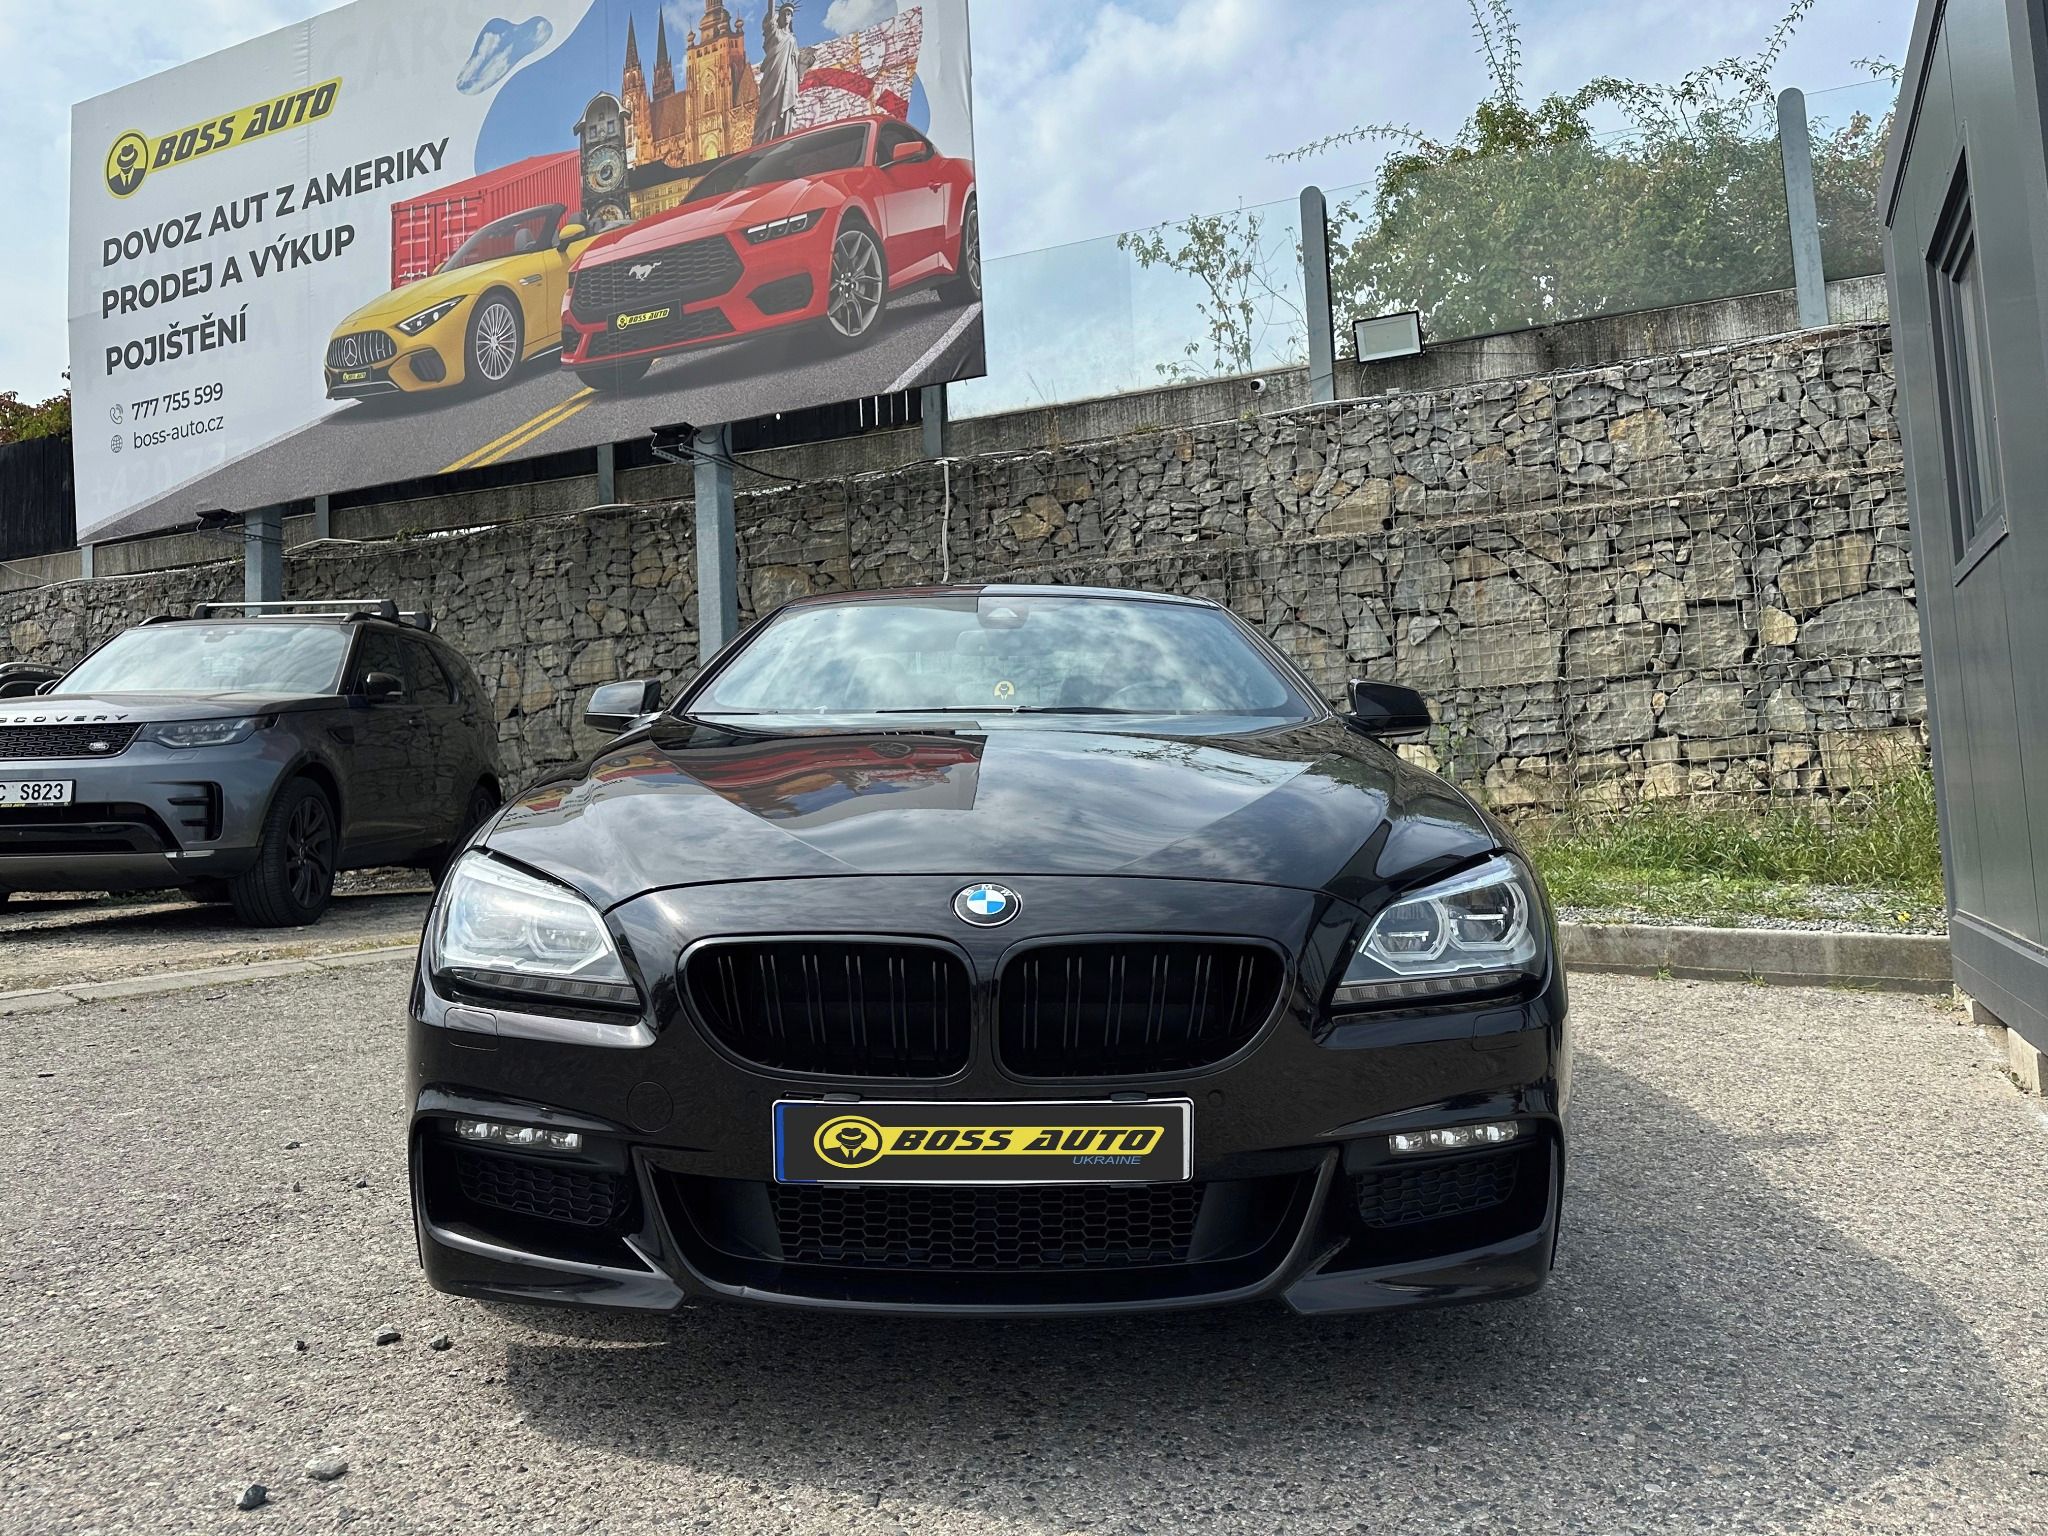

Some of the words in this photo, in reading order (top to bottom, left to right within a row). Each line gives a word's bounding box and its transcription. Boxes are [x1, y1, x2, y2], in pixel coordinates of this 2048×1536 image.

[152, 115, 236, 169] BOSS
[241, 82, 337, 141] AUTO
[103, 211, 202, 267] DOVOZ
[208, 192, 269, 237] AUT
[275, 184, 295, 217] Z
[302, 137, 449, 209] AMERIKY
[102, 261, 213, 319] PRODEJ
[220, 256, 243, 288] A
[249, 224, 355, 278] VÝKUP
[106, 303, 249, 375] POJIŠTĚNÍ
[131, 398, 159, 421] 777
[163, 390, 191, 413] 755
[194, 382, 224, 406] 599
[133, 416, 224, 449] boss-auto.cz
[20, 783, 64, 800] S823
